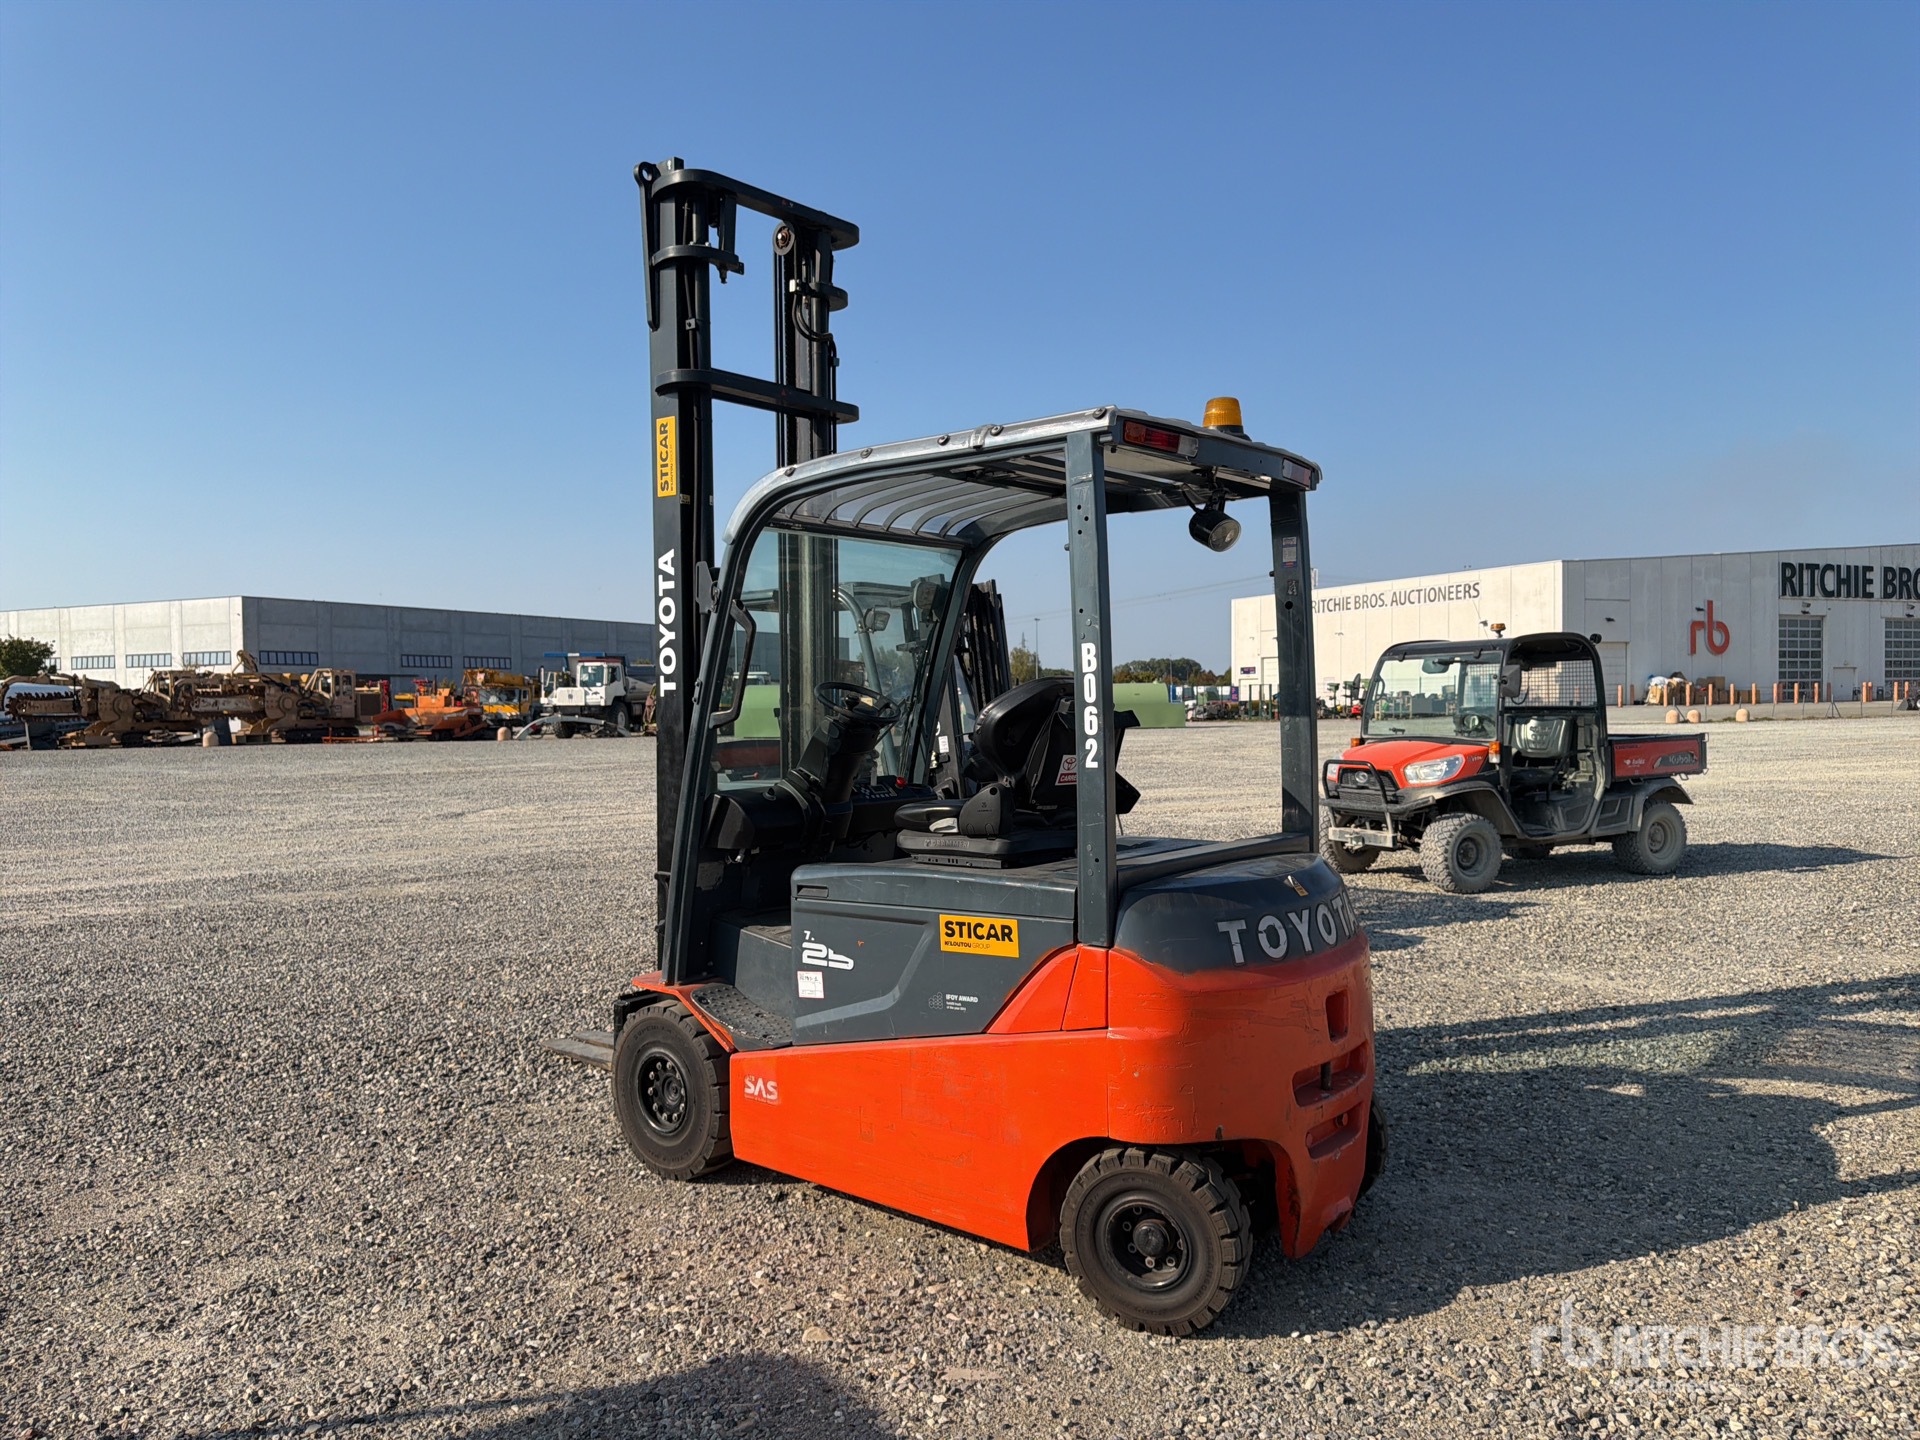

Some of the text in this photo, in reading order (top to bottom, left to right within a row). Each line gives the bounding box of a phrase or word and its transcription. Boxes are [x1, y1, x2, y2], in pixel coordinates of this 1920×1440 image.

[659, 421, 669, 492] STICAR
[1354, 592, 1388, 610] BROS.
[1390, 582, 1480, 607] AUCTIONEERS
[1781, 562, 1875, 598] RITCHIE
[658, 548, 677, 697] TOYOTA
[1688, 599, 1730, 656] rb
[1081, 642, 1099, 769] B062
[944, 920, 1014, 943] STICAR
[972, 942, 991, 950] GROUP
[959, 995, 979, 1003] AWARD
